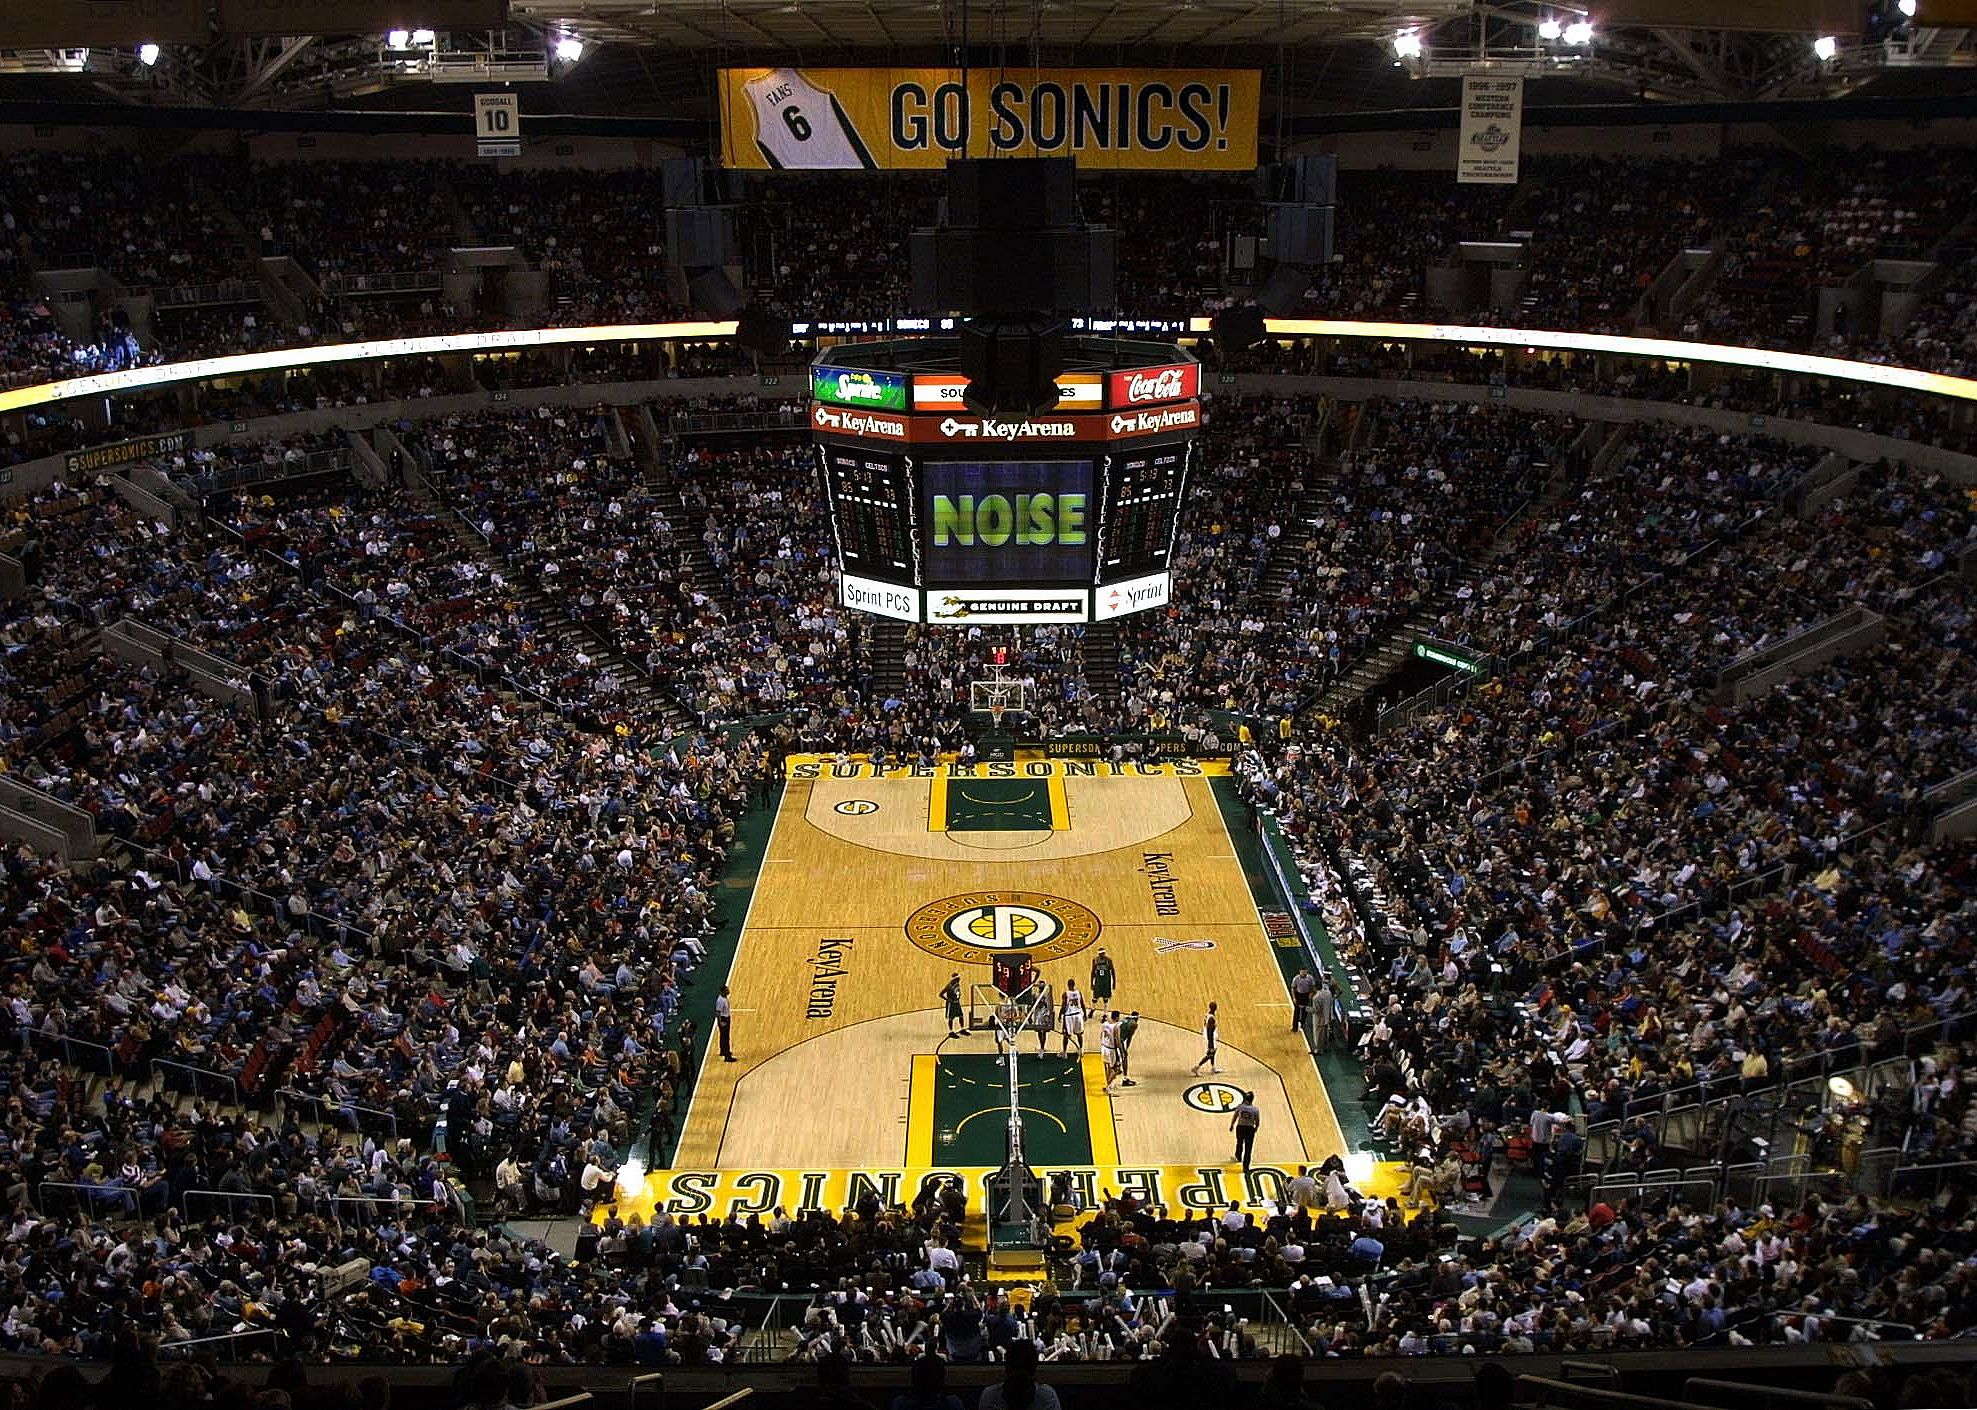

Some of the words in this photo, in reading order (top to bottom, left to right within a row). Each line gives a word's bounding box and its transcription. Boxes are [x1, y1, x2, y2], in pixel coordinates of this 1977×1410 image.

[765, 83, 793, 107] FANS
[485, 109, 509, 131] 10
[782, 105, 812, 142] 6
[892, 82, 970, 151] GO
[990, 82, 1230, 151] SONICS!
[940, 388, 965, 398] SOU
[1128, 369, 1185, 403] Coca-Cola
[842, 412, 905, 437] KeyArena
[981, 419, 1076, 442] KeyArena
[1137, 409, 1196, 433] KeyArena
[932, 493, 1087, 547] NOISE
[847, 583, 881, 607] Sprint
[886, 592, 910, 613] PCS
[969, 602, 1028, 611] GENUINE
[1033, 602, 1079, 611] DRAFT
[1126, 583, 1163, 609] Sprint
[792, 762, 1204, 779] SUPERSONICS
[1137, 853, 1180, 916] KeyArena
[806, 938, 854, 1019] KeyArena
